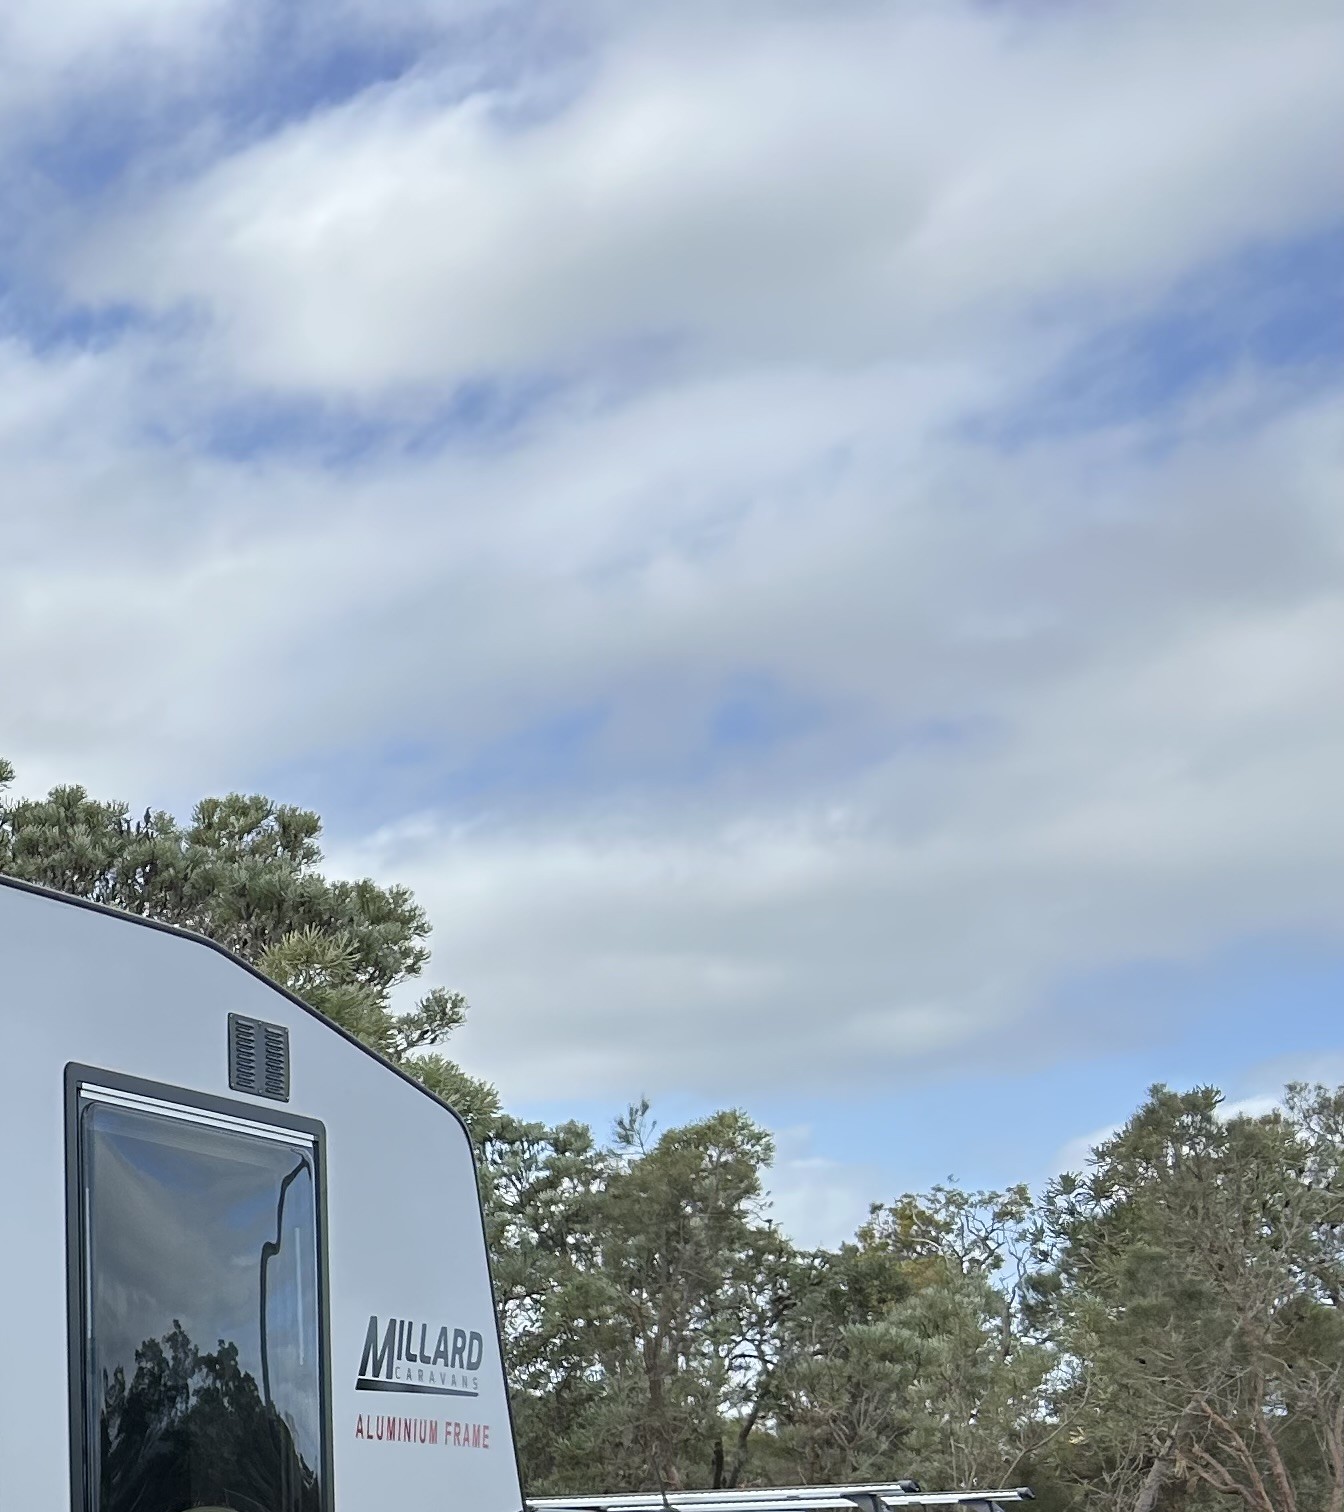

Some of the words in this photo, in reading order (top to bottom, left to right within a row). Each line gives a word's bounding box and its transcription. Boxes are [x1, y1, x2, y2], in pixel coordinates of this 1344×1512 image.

[358, 1315, 483, 1380] MILLARD
[395, 1366, 479, 1391] CARAVANS
[355, 1413, 438, 1445] ALUMINIUM
[444, 1421, 490, 1449] FRAME
